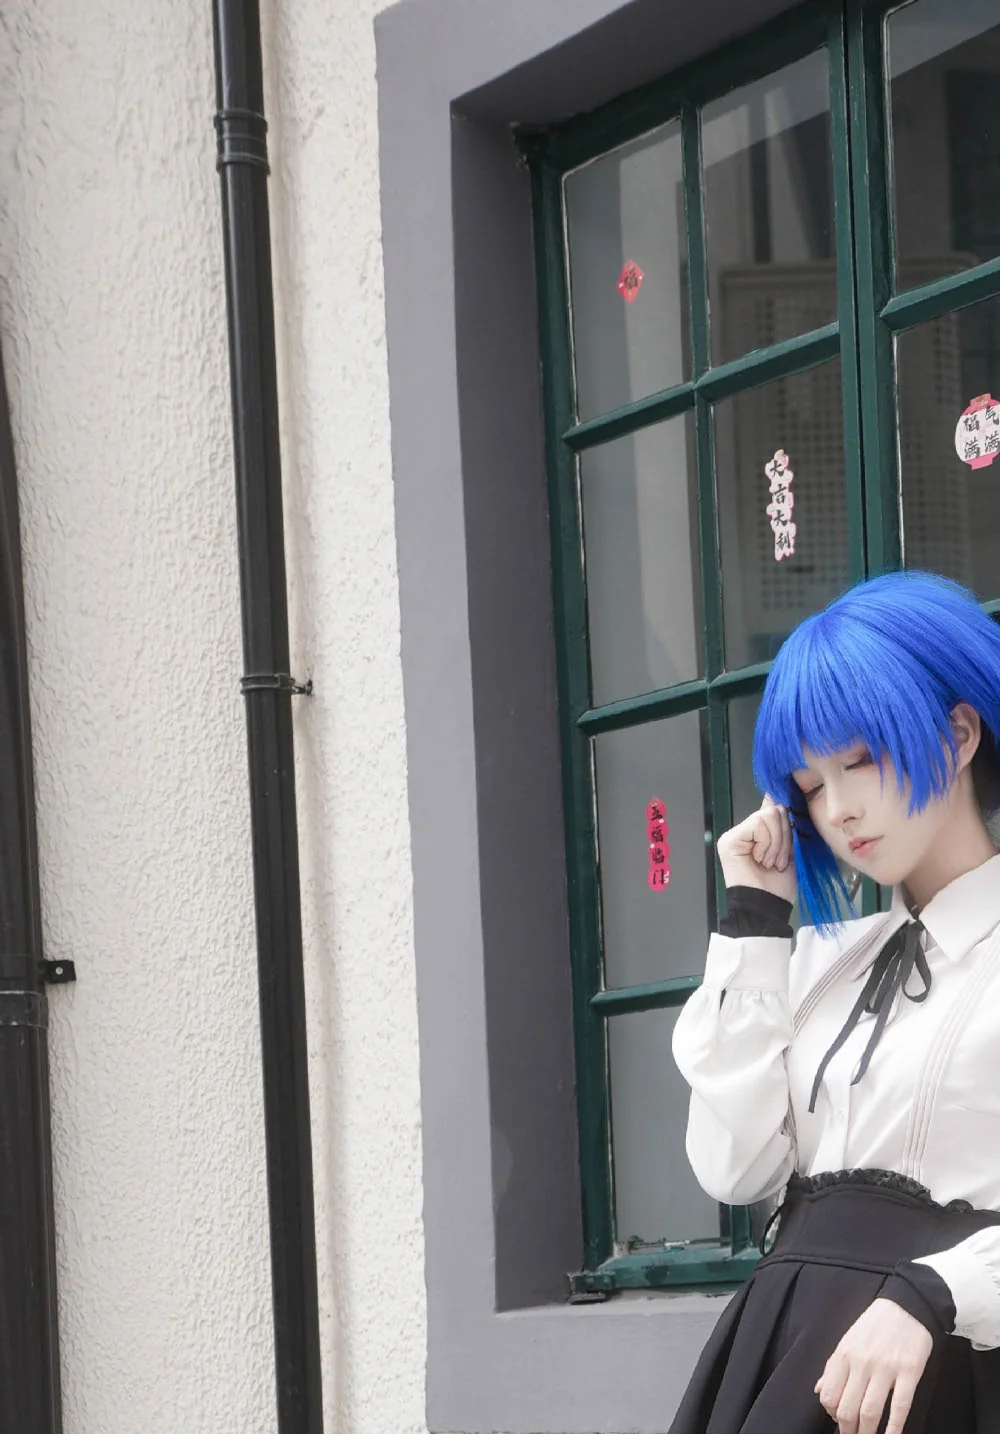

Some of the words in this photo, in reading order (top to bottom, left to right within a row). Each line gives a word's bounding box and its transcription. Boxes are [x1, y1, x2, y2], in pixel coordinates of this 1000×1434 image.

[770, 460, 791, 551] 大吉大利
[651, 805, 666, 885] 五福临门
